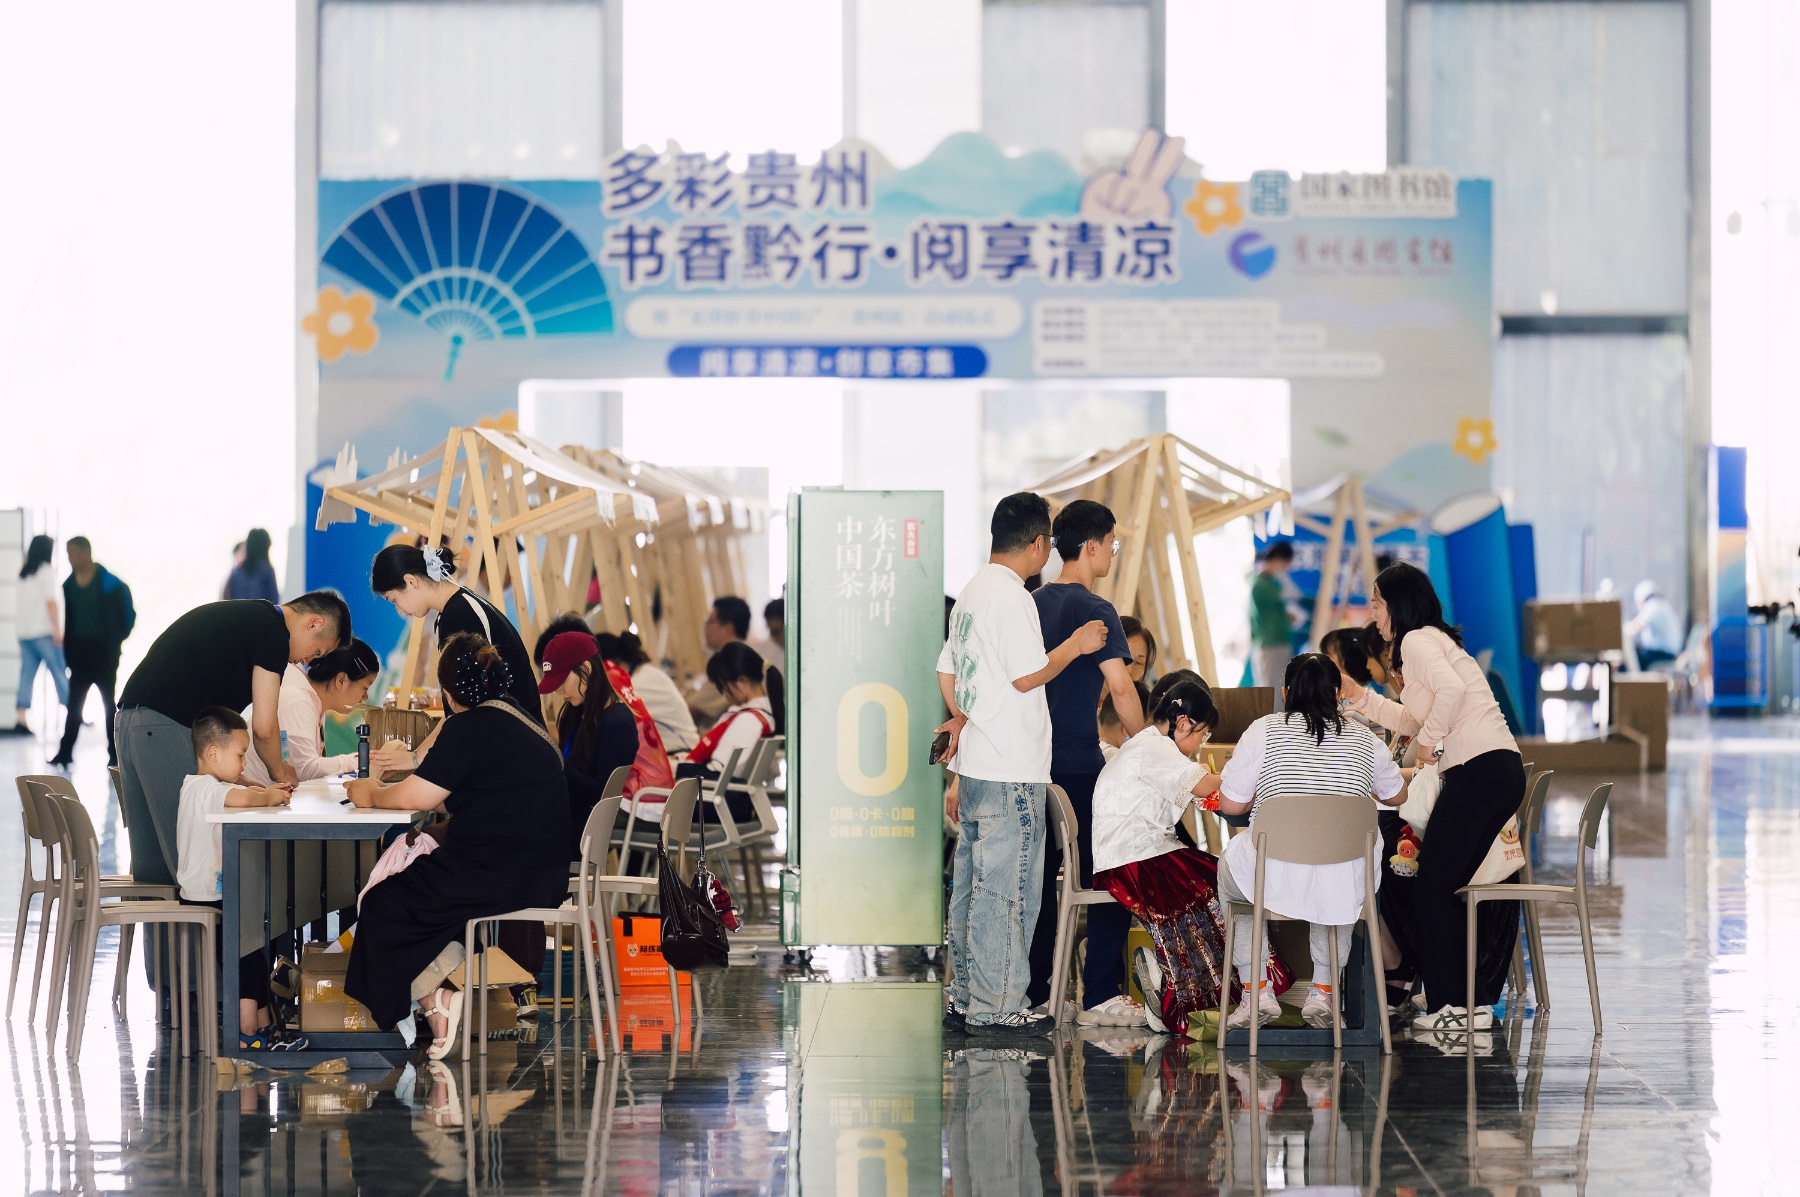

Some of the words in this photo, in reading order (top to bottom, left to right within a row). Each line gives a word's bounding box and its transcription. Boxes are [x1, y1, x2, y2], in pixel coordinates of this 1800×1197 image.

[606, 150, 869, 211] 多彩贵州
[607, 222, 1176, 282] 书香黔行·阅享清凉
[835, 516, 864, 599] 中国茶
[868, 516, 897, 627] 东方树叶
[837, 682, 909, 796] 0
